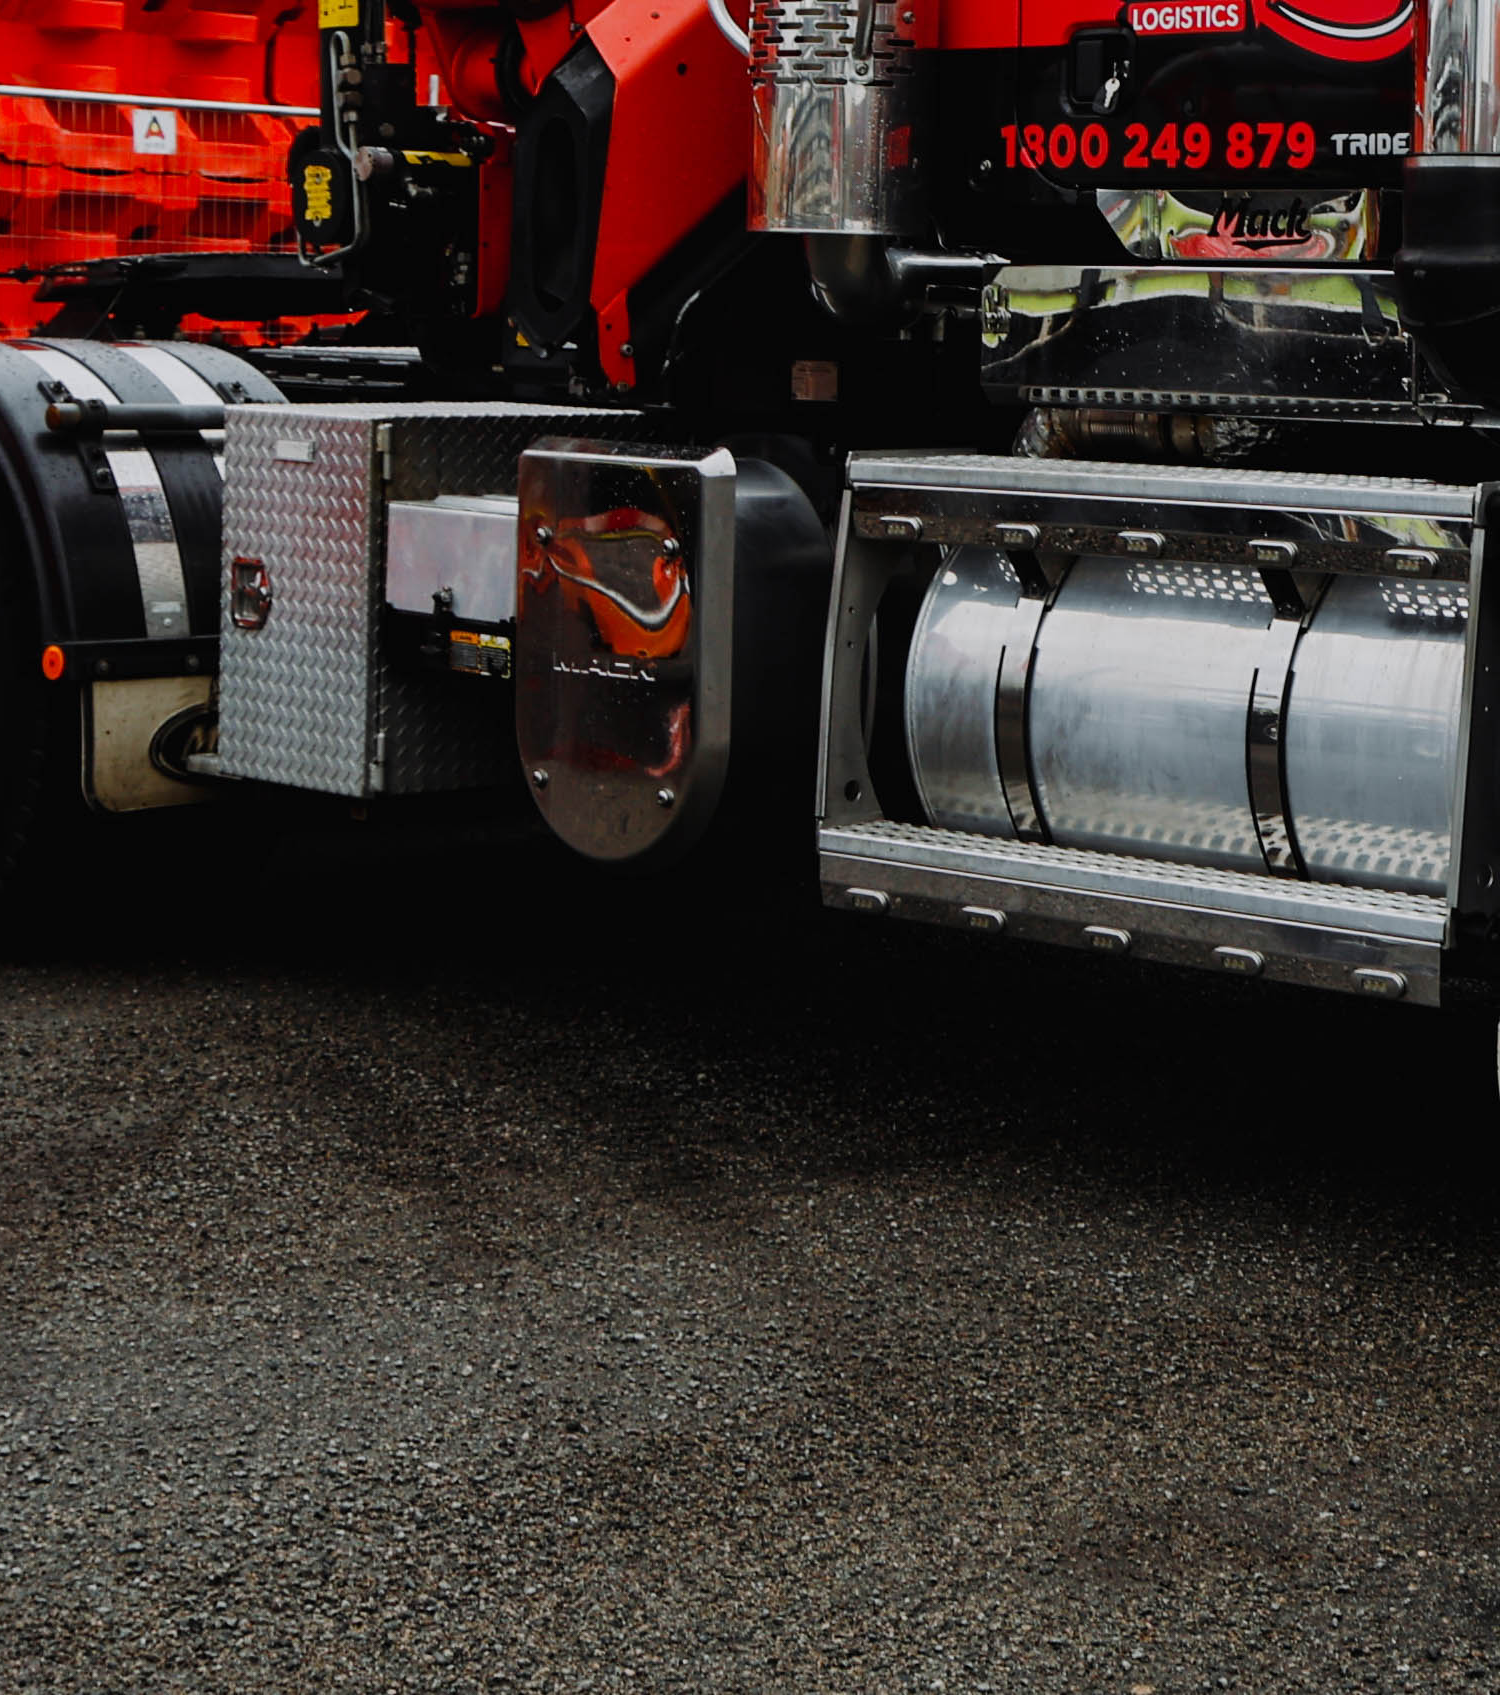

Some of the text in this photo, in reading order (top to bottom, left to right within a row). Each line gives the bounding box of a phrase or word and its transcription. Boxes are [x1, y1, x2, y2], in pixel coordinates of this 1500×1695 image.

[1131, 3, 1240, 32] LOGISTICS
[1002, 122, 1110, 169] 1800
[1123, 122, 1211, 169] 249
[1226, 121, 1316, 169] 879
[1207, 197, 1312, 250] Mack
